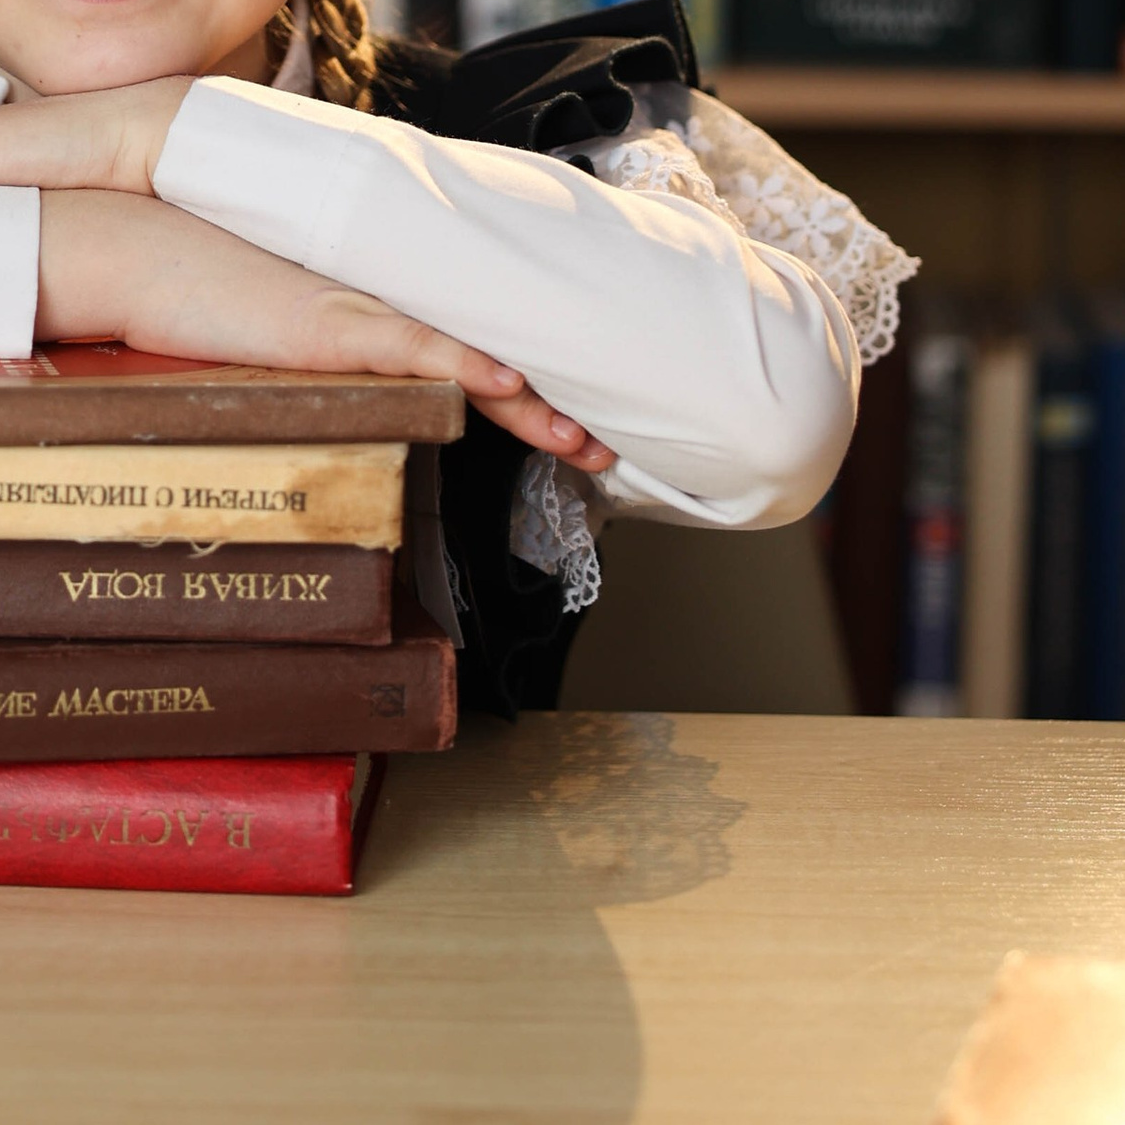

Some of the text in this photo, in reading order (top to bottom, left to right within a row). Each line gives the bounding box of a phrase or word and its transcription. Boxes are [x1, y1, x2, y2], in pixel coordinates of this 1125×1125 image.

[155, 486, 174, 507] С
[182, 487, 308, 513] ВСТРЕЧИ
[59, 567, 332, 602] ЖИВАЯ ВОДА
[48, 685, 215, 720] МАСТЕРА
